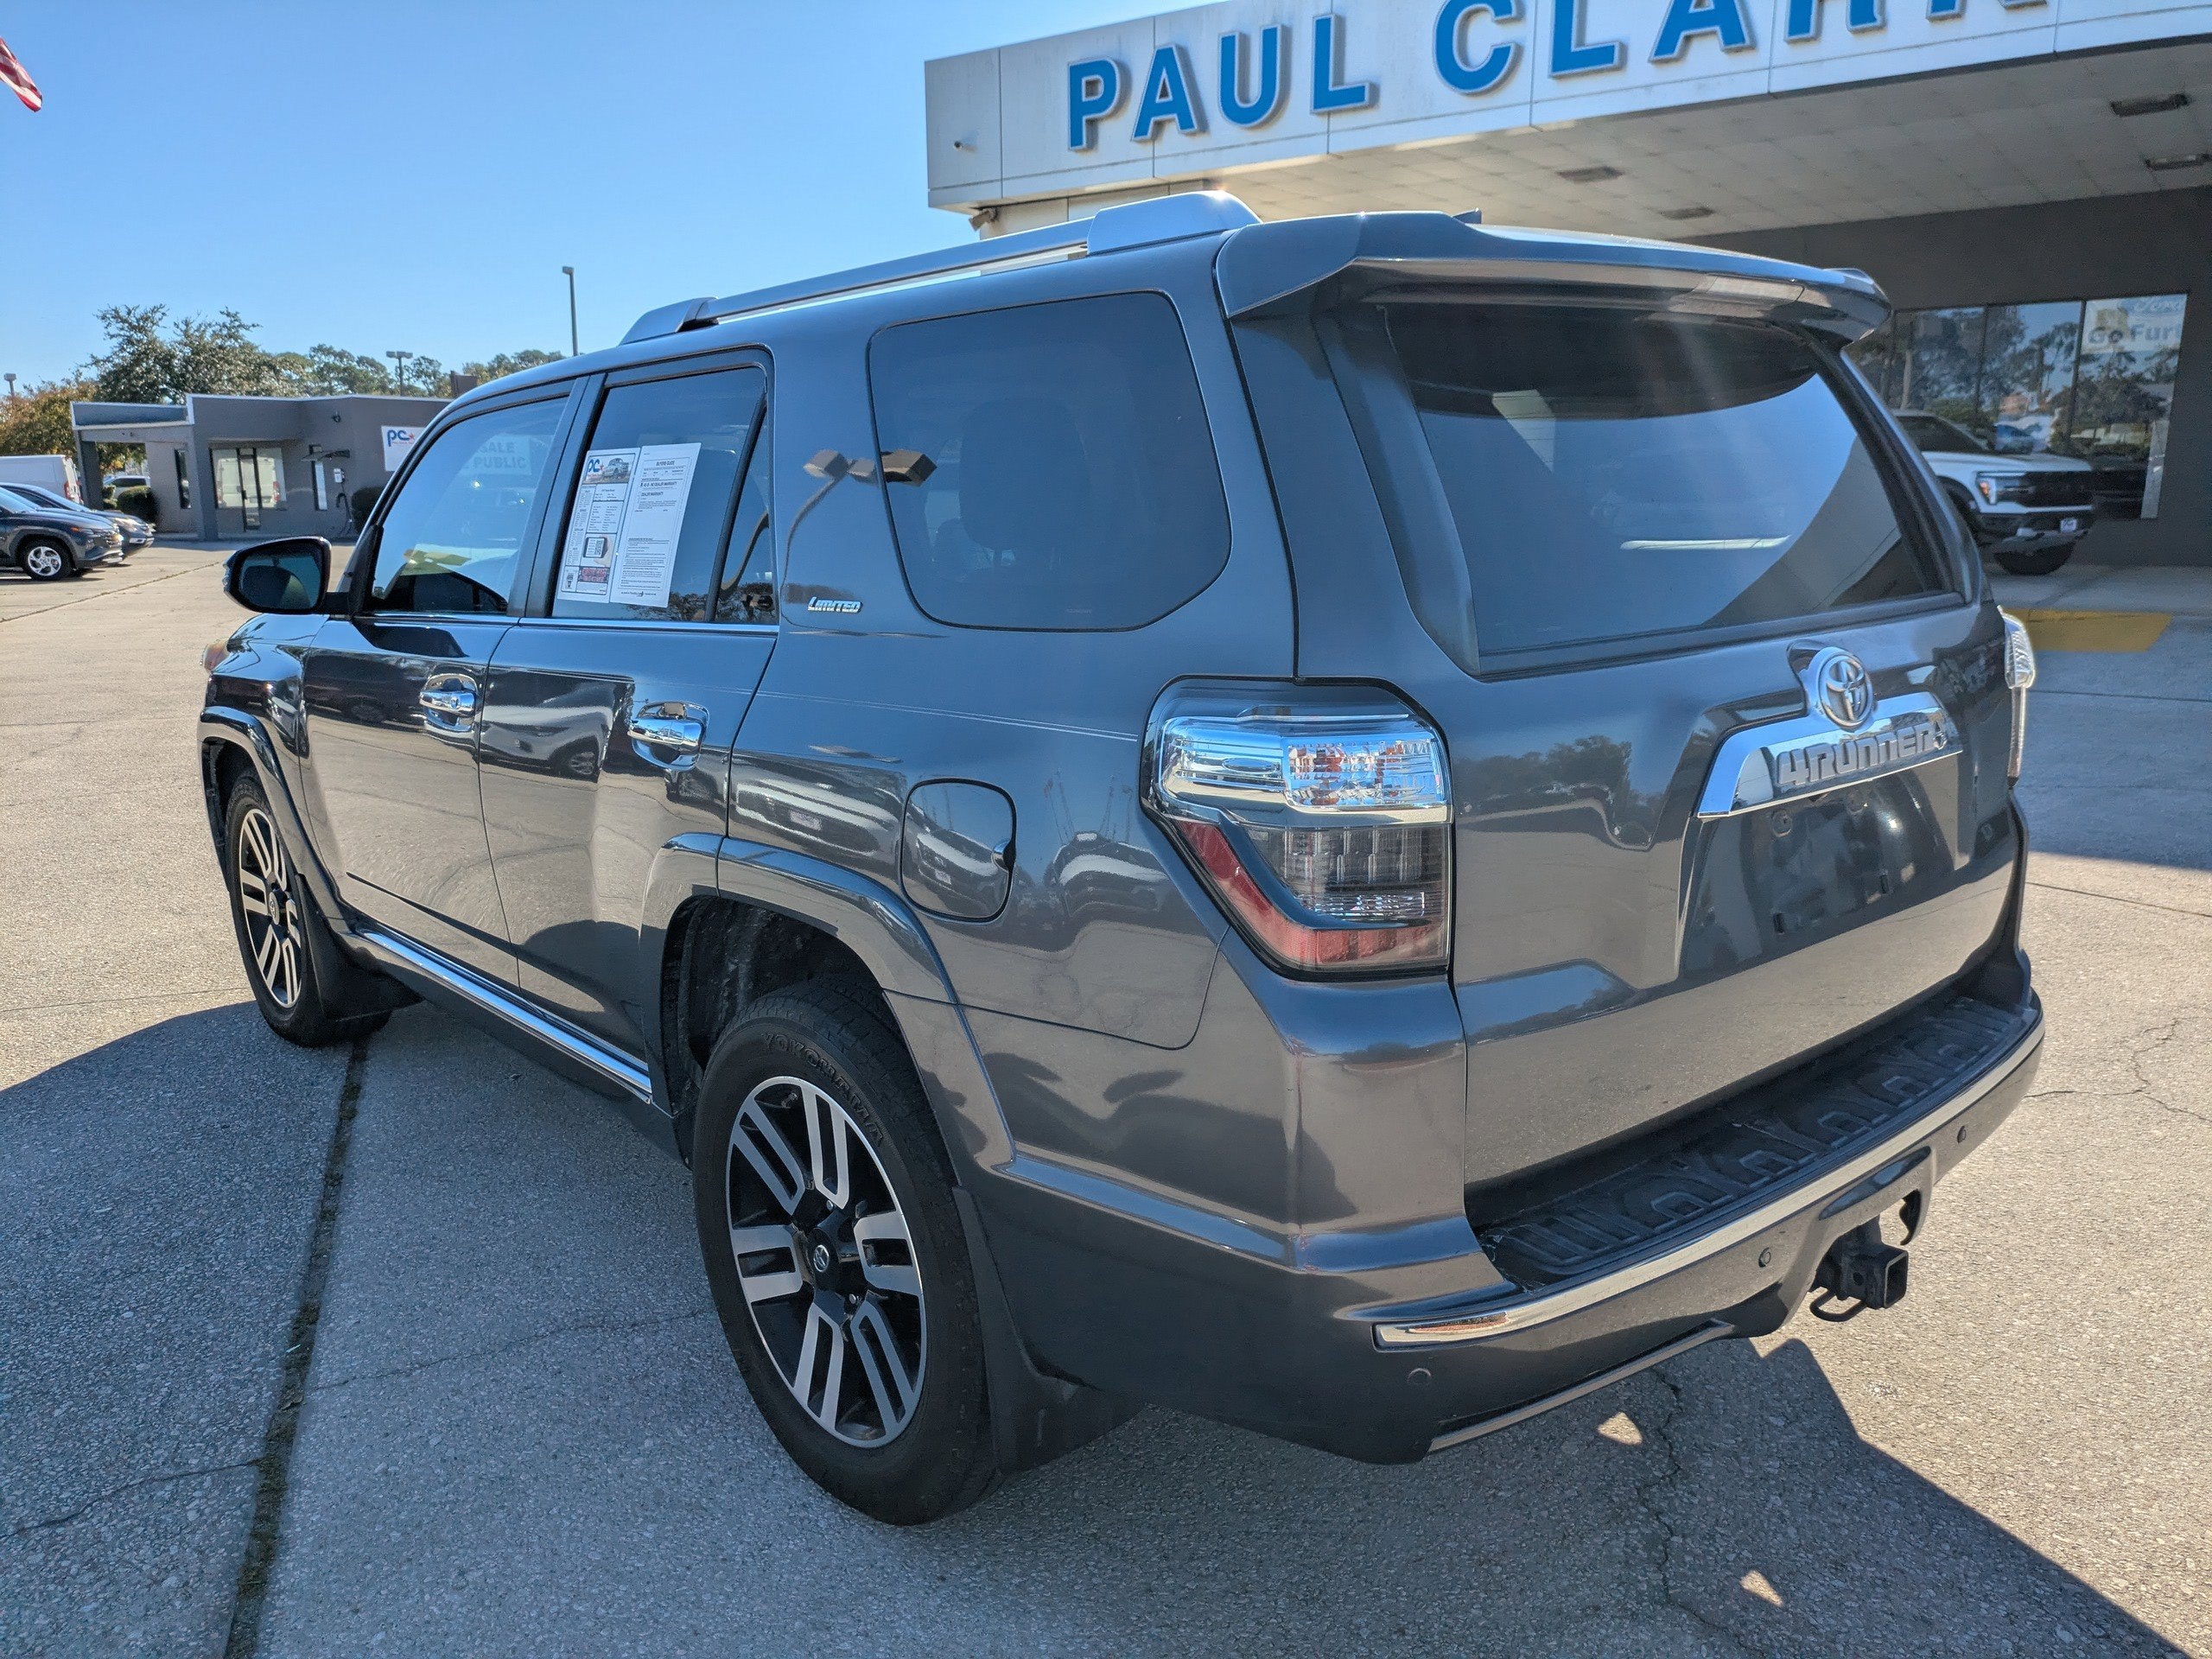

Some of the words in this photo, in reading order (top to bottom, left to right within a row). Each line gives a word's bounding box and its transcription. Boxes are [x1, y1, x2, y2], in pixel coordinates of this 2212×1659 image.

[1067, 13, 1375, 152] PAUL
[1433, 0, 2047, 96] CLA
[1776, 722, 1942, 786] 4RUNNER
